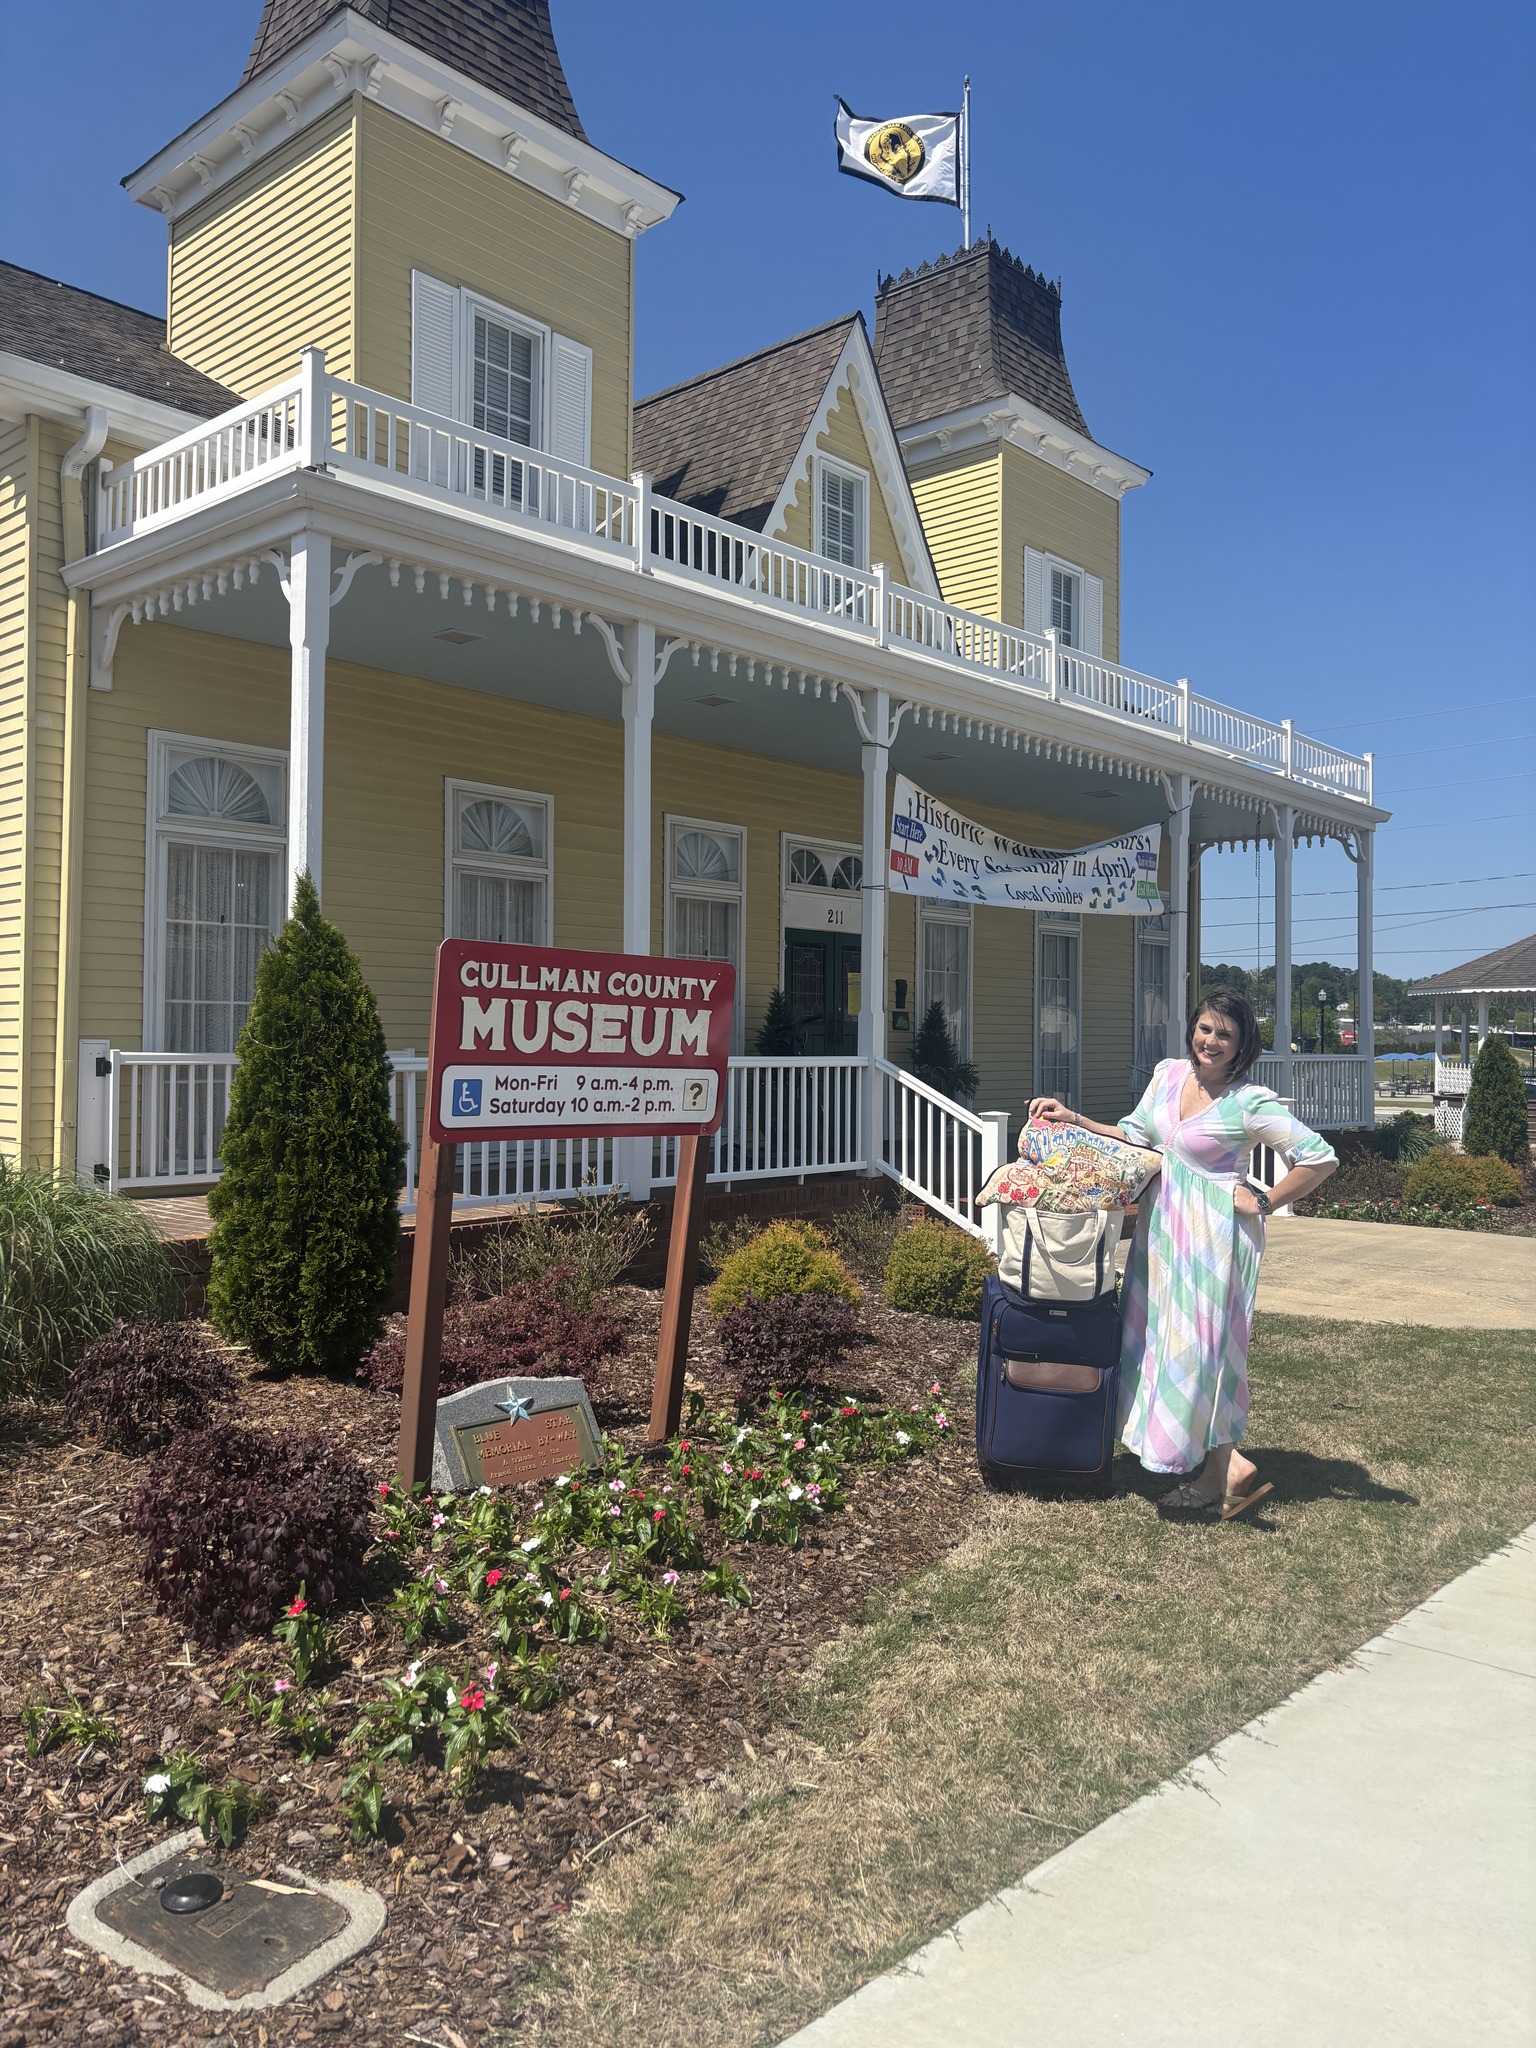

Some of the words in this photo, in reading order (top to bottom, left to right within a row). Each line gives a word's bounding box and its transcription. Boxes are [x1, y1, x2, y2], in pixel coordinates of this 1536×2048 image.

[895, 817, 909, 838] Start
[909, 822, 923, 841] Here
[915, 790, 984, 845] Historic
[903, 859, 913, 875] AM
[938, 838, 979, 880] Every
[1072, 860, 1087, 877] in
[1090, 855, 1132, 885] April
[1004, 883, 1043, 902] Local
[1041, 885, 1084, 905] Guides
[828, 909, 843, 924] 211
[460, 960, 601, 994] CULLMAN
[607, 972, 718, 1001] COUNTY
[459, 996, 713, 1057] MUSEUM
[495, 1075, 558, 1091] Mon-Fri
[576, 1075, 586, 1091] 9
[590, 1076, 639, 1091] a.m.-4
[642, 1078, 674, 1094] p.m.
[489, 1097, 567, 1116] Saturday
[570, 1097, 589, 1113] 10
[593, 1097, 640, 1113] a.m.-2
[644, 1099, 675, 1115] p.m.
[473, 1430, 501, 1444] BLUE
[545, 1415, 573, 1429] STAR
[477, 1440, 531, 1460] MEMORIAL
[537, 1429, 577, 1446] BY-WAY
